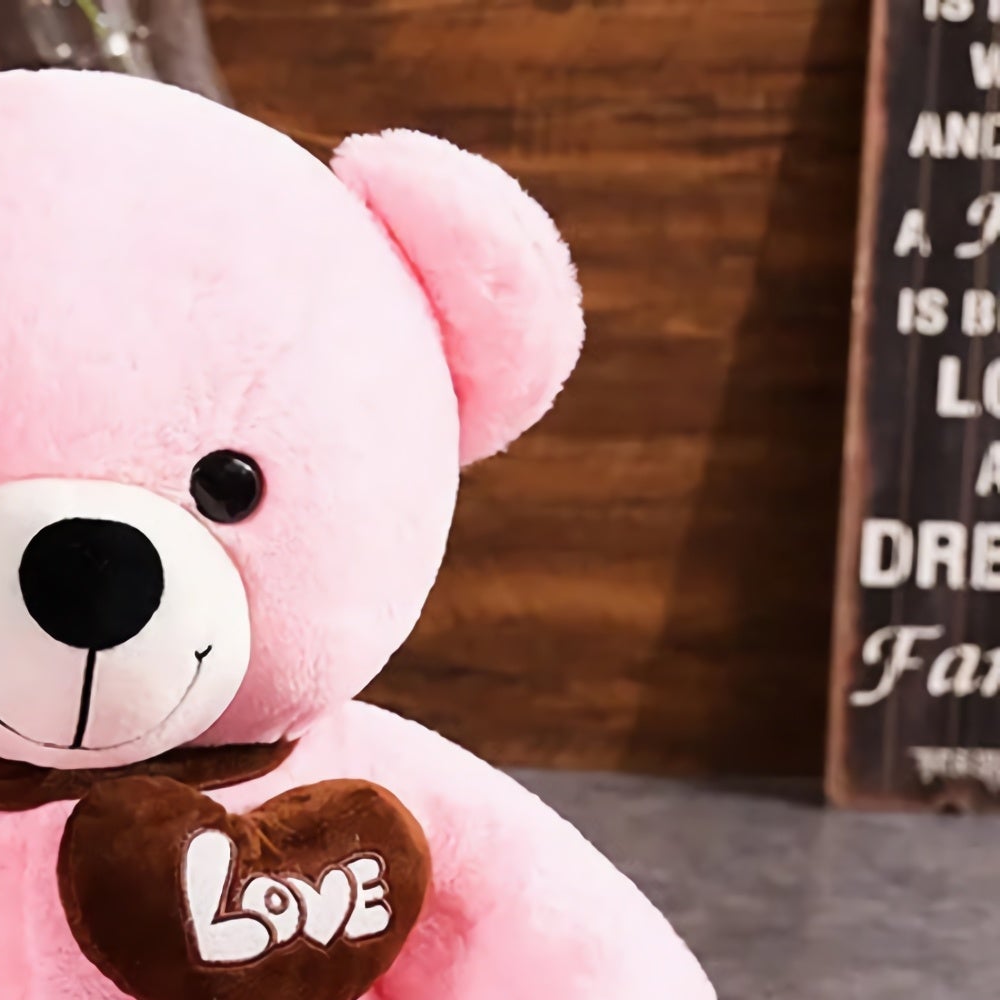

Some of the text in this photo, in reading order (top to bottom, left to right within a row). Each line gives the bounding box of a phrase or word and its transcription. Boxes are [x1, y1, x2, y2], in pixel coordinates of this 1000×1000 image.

[894, 208, 932, 257] A
[897, 286, 949, 336] IS
[182, 828, 392, 966] LOVE
